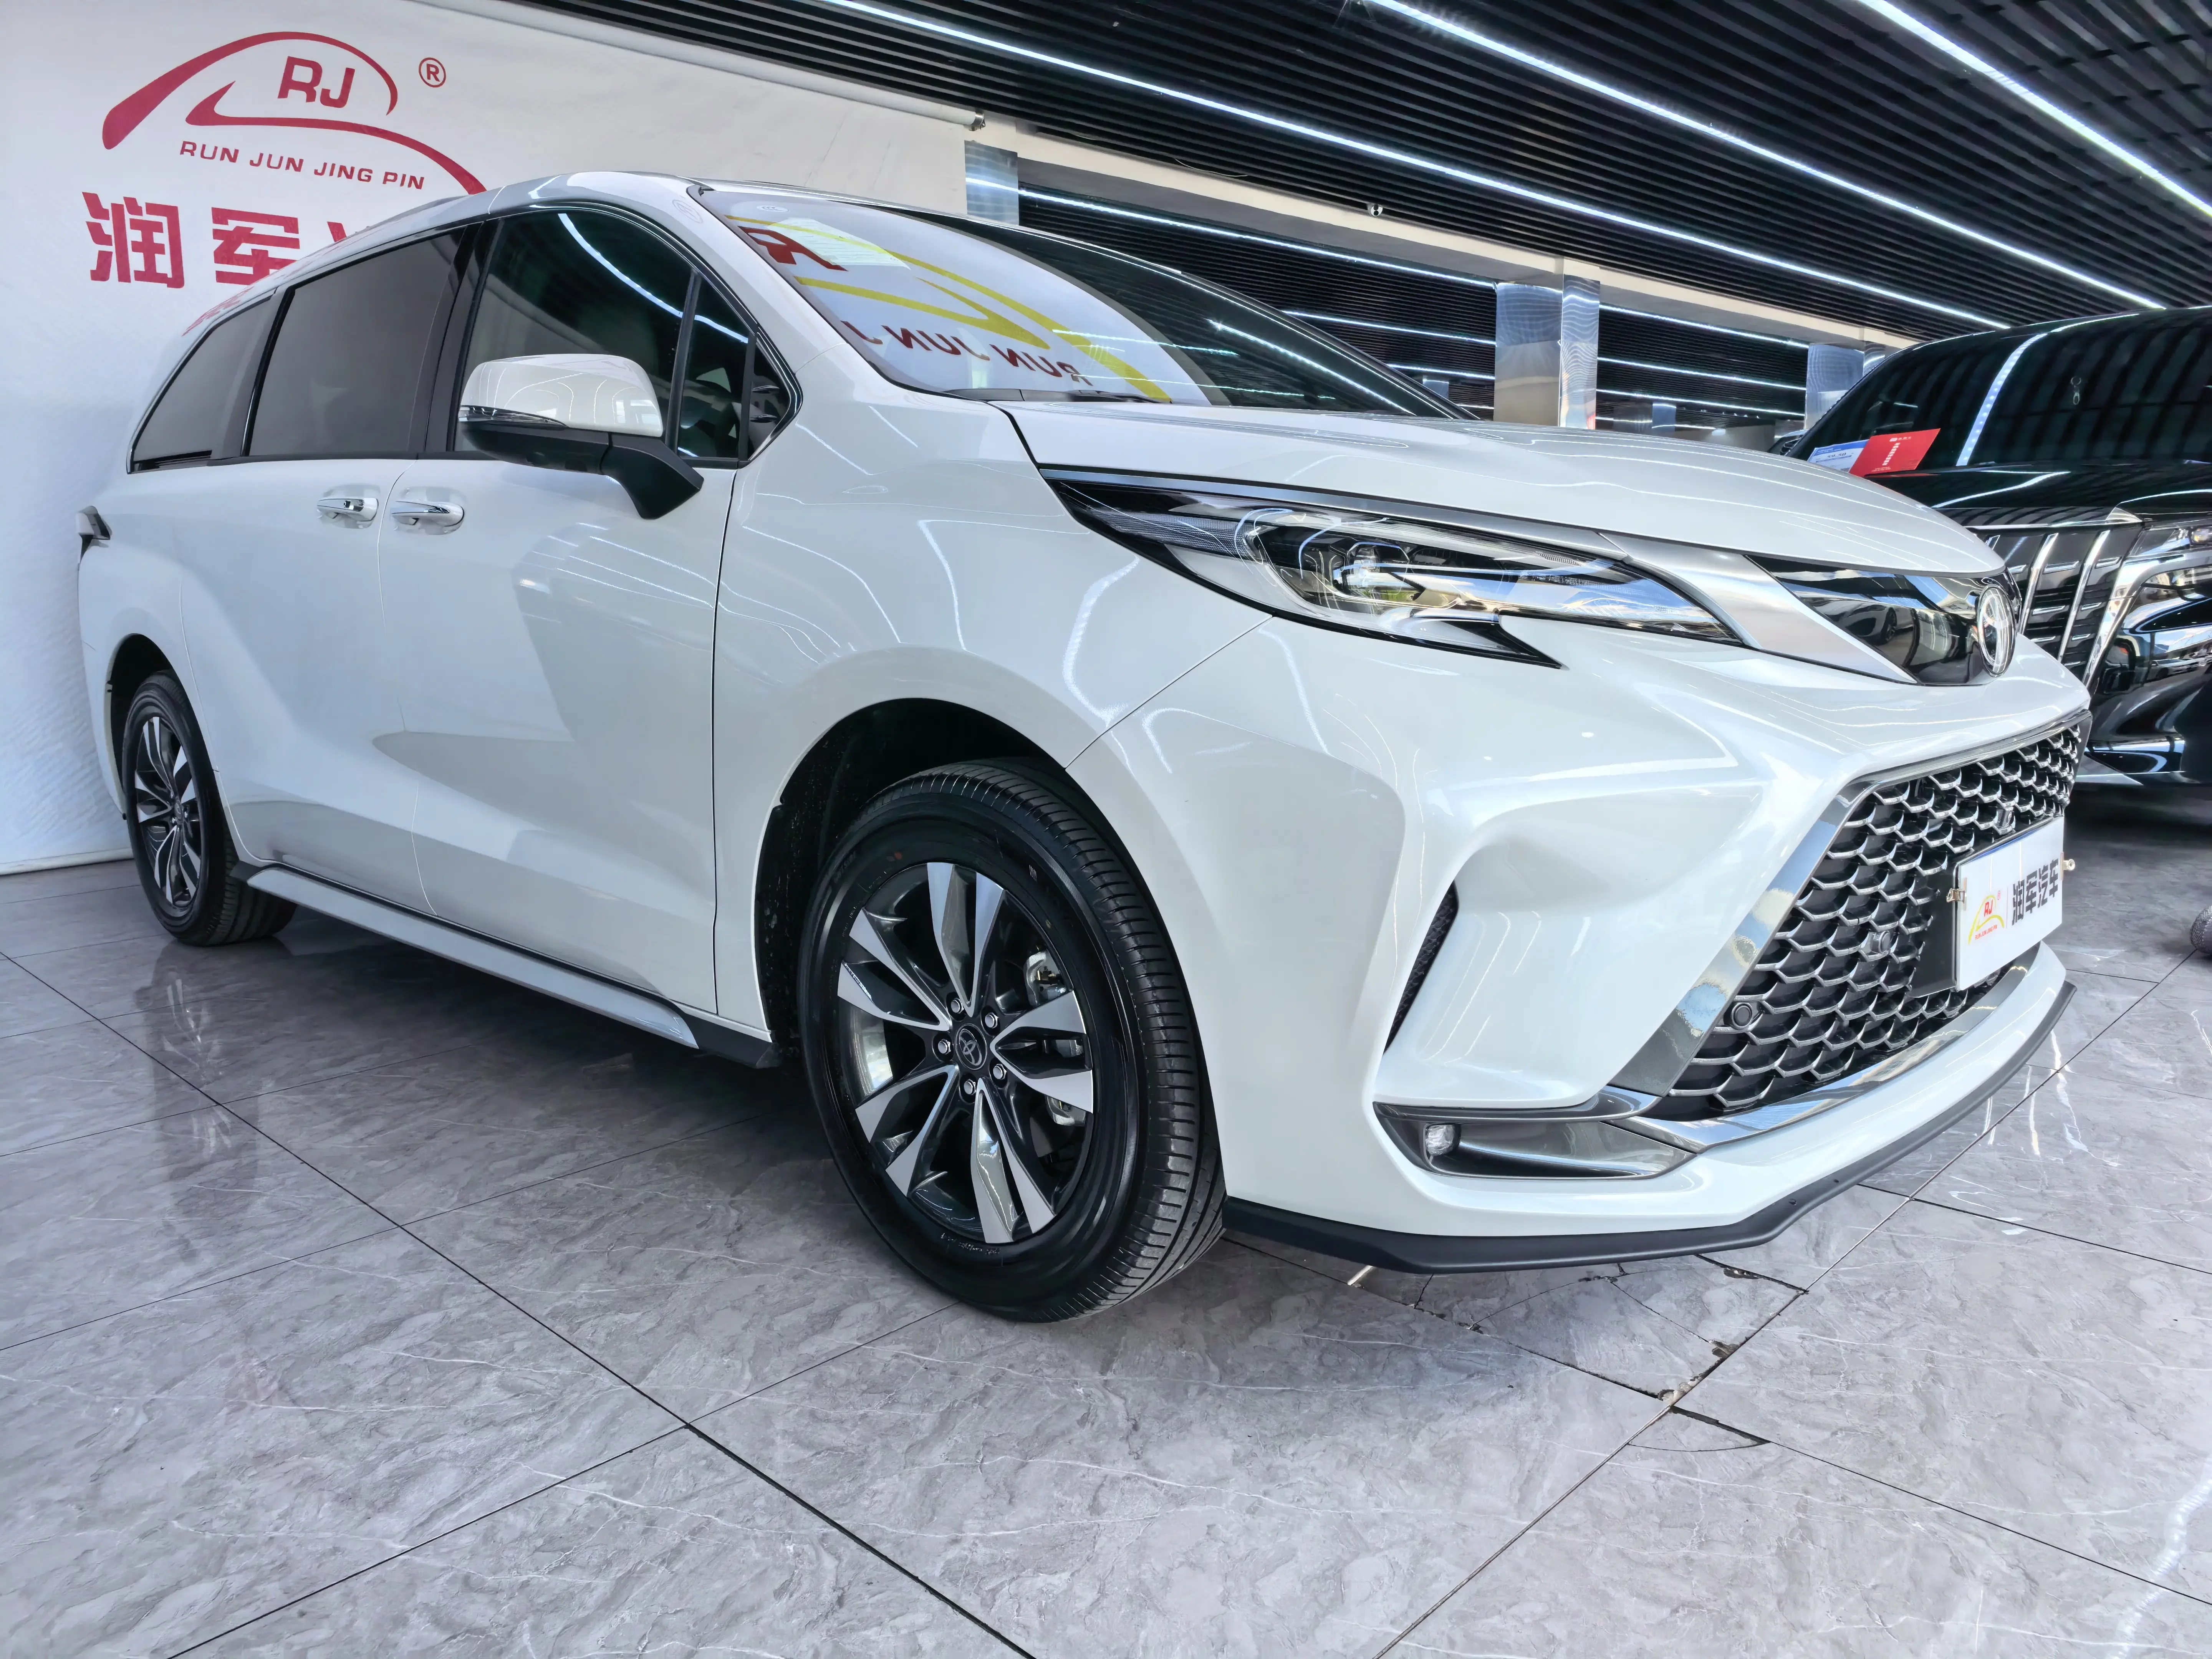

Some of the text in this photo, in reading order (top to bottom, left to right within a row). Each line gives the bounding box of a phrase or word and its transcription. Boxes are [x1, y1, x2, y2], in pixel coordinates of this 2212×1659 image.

[278, 56, 355, 108] RJ
[180, 141, 425, 190] RUN JUN JING PIN
[1984, 899, 1993, 917] RJ
[2012, 858, 2059, 926] 润军汽车
